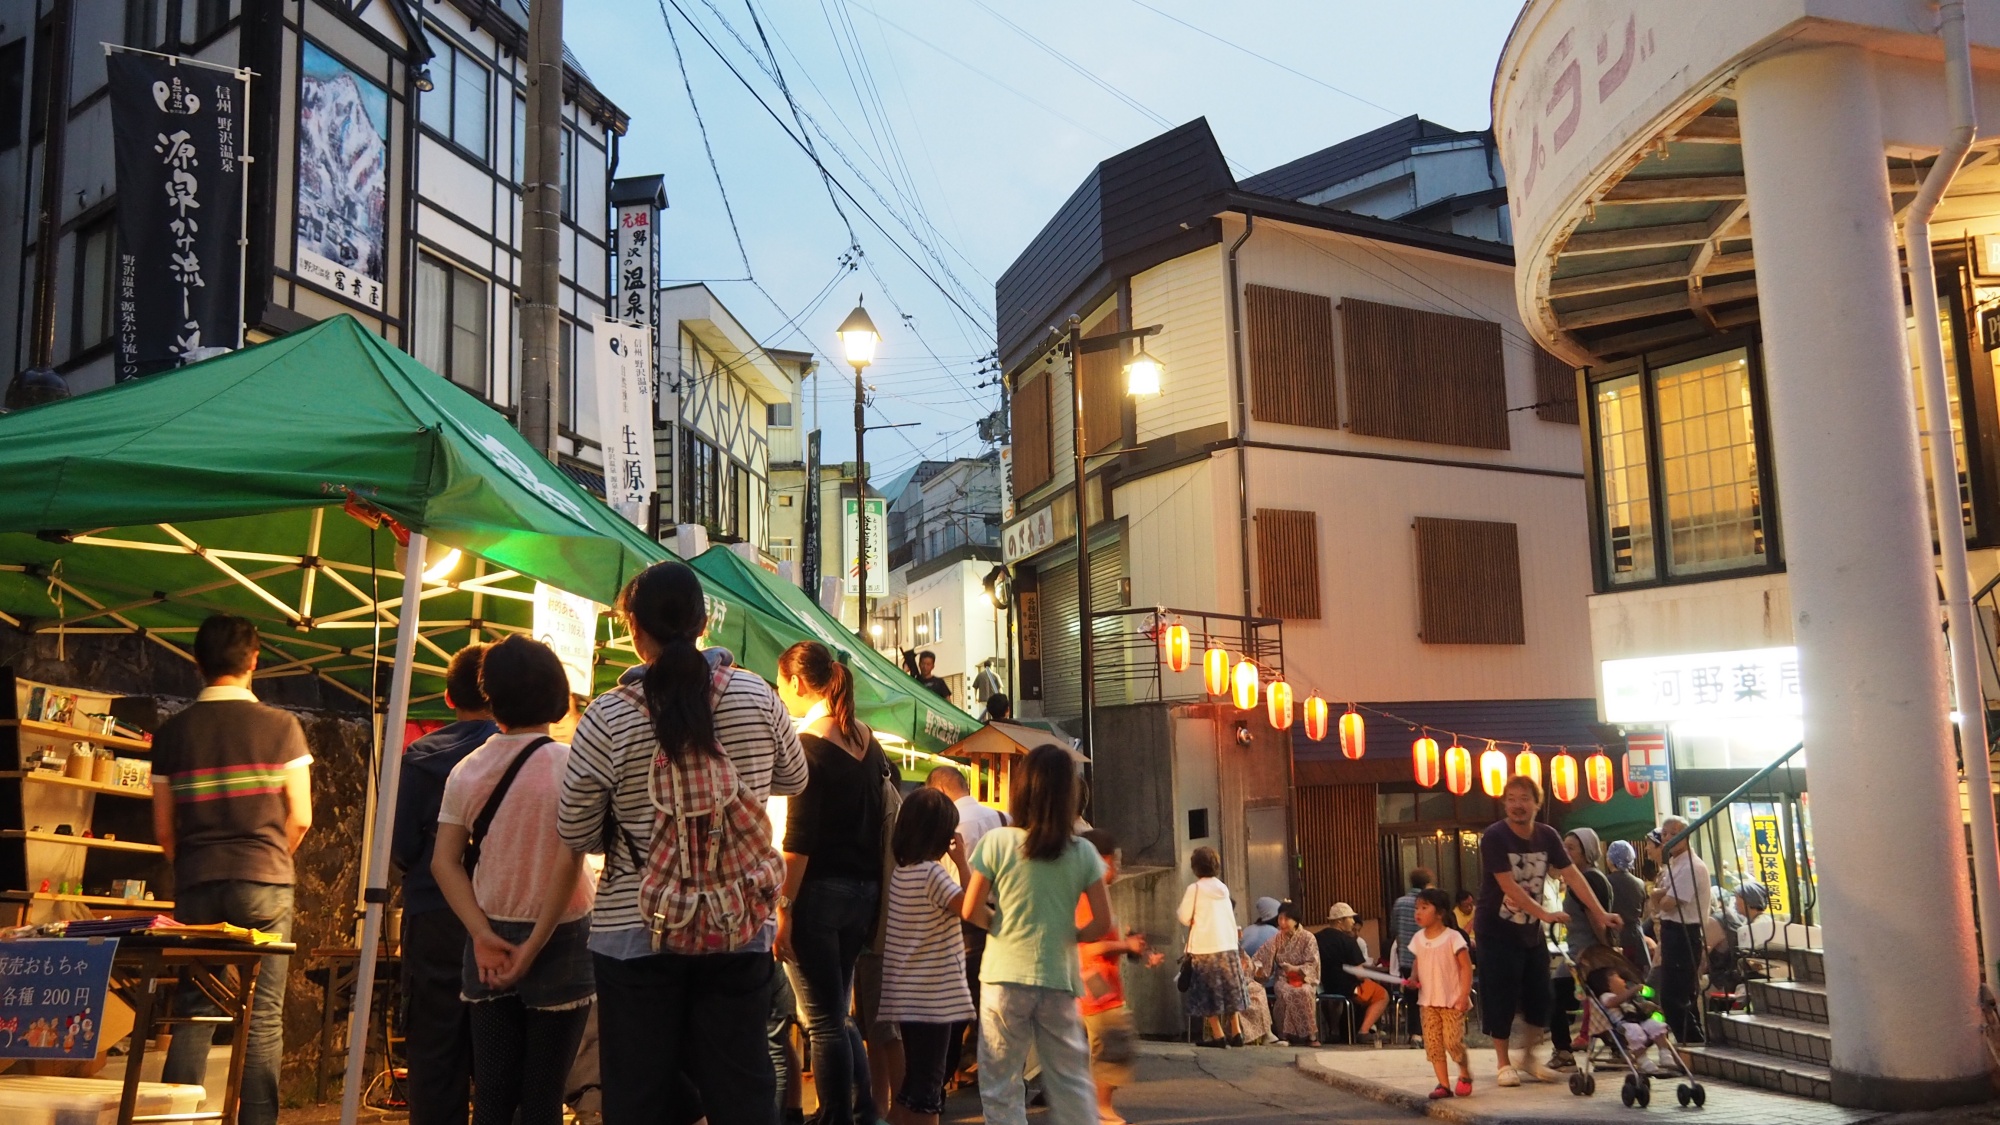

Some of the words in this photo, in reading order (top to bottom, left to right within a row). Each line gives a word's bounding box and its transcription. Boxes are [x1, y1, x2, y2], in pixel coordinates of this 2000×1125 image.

[215, 85, 232, 114] 信州
[217, 116, 234, 173] 野沢温泉
[622, 212, 649, 228] 元祖
[122, 253, 135, 298] 野沢温泉
[634, 359, 648, 395] 野沢温泉
[1653, 662, 1801, 706] 河野薬局
[3, 986, 35, 1006] 各種
[42, 988, 70, 1006] 200
[74, 987, 90, 1006] 円
